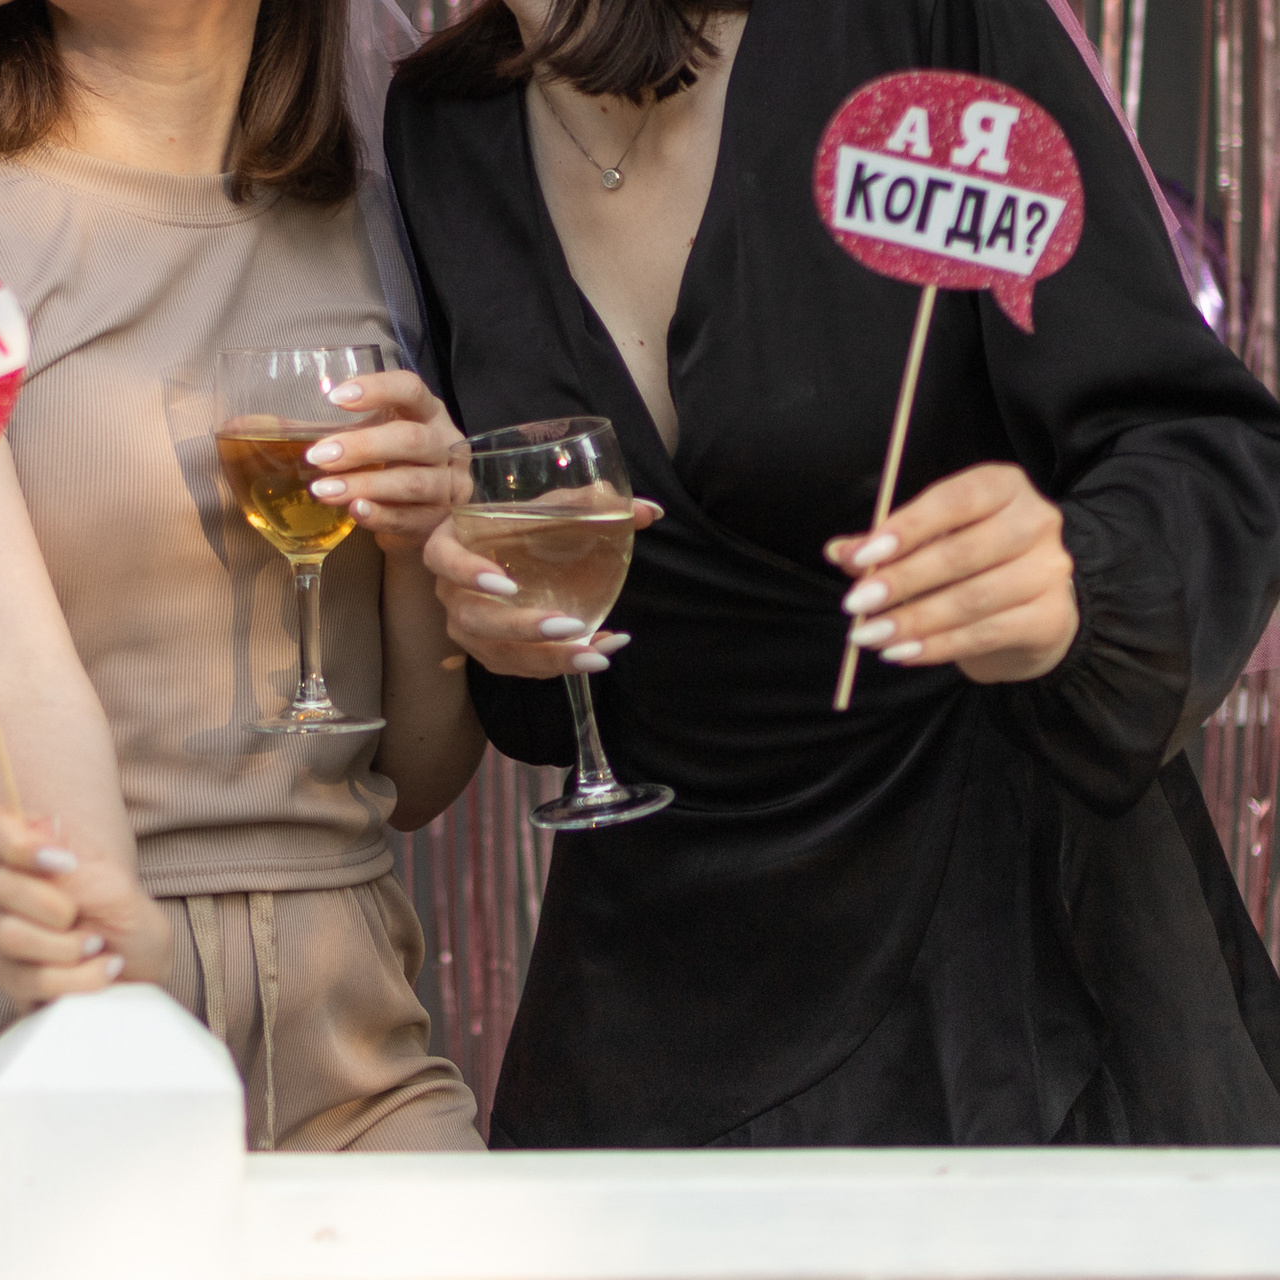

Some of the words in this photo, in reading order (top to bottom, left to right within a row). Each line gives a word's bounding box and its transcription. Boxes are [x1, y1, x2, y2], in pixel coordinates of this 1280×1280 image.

[886, 106, 932, 158] А
[950, 100, 1020, 175] Я
[844, 162, 1048, 256] КОГДА?
